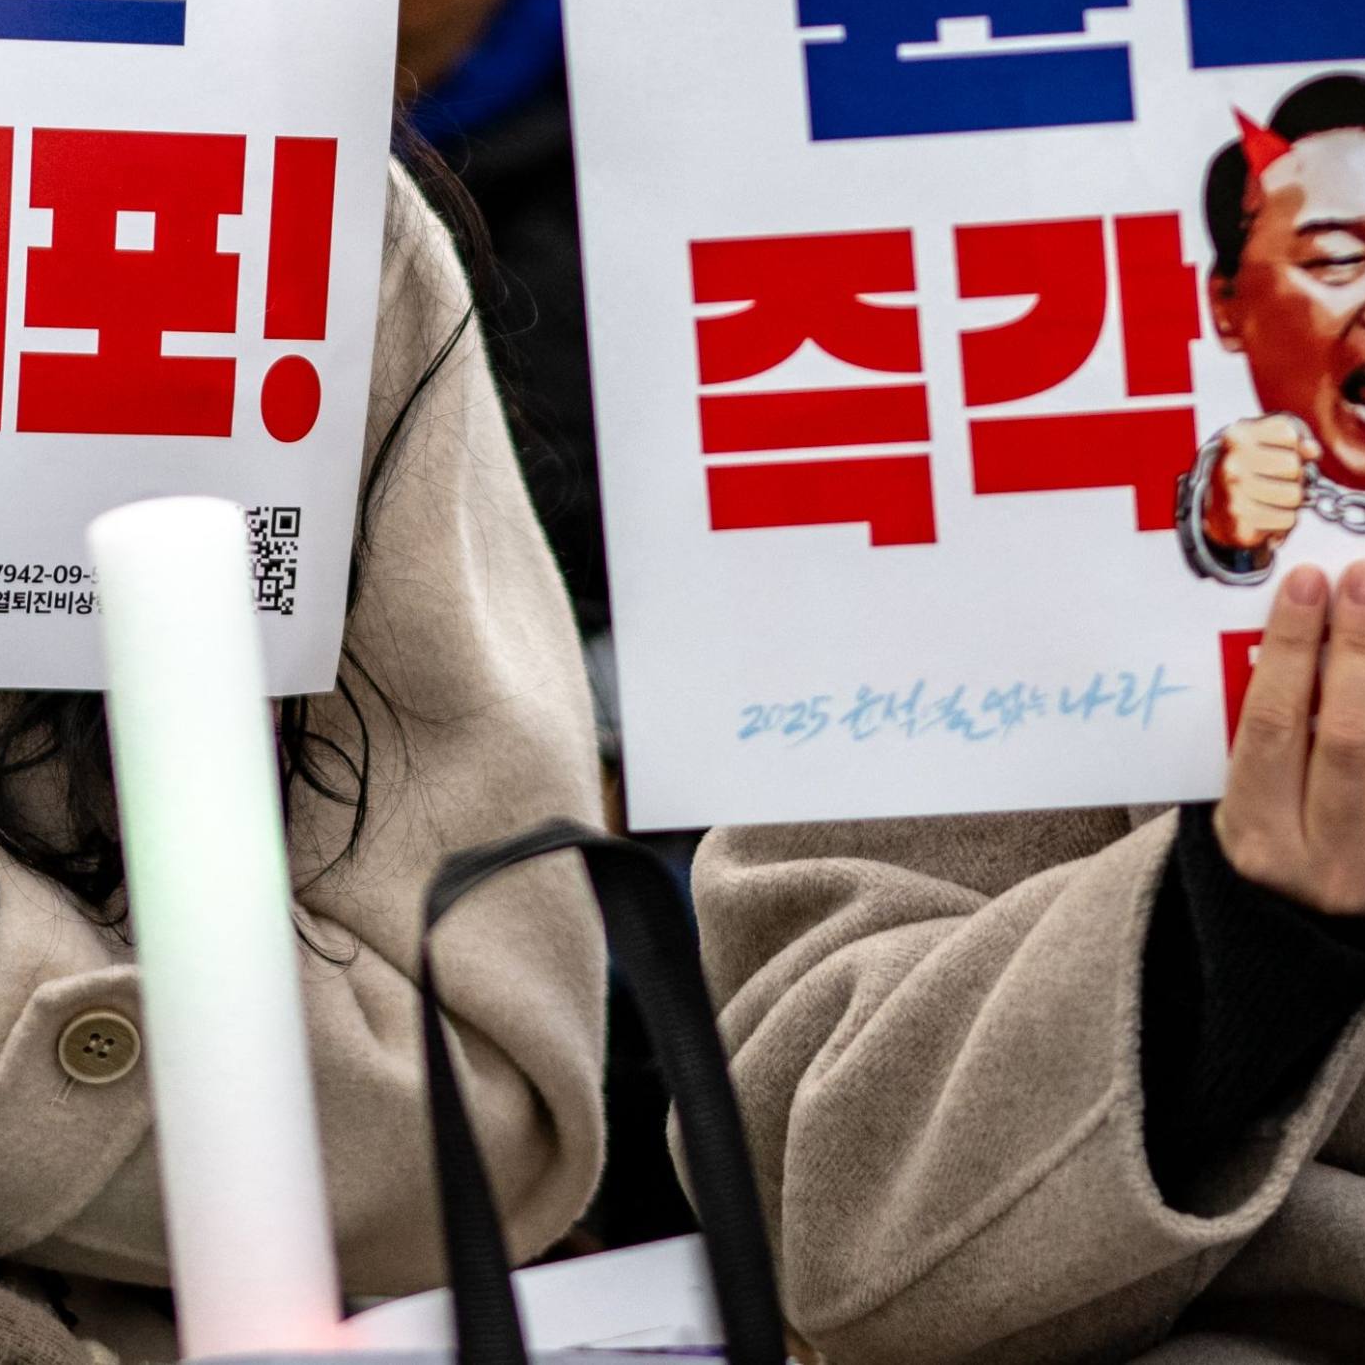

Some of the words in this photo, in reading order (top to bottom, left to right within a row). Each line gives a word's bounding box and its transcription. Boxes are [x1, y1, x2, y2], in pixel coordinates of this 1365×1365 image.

[689, 211, 1202, 547] 즉각
[737, 695, 833, 747] 2025
[1059, 663, 1194, 731] 나라
